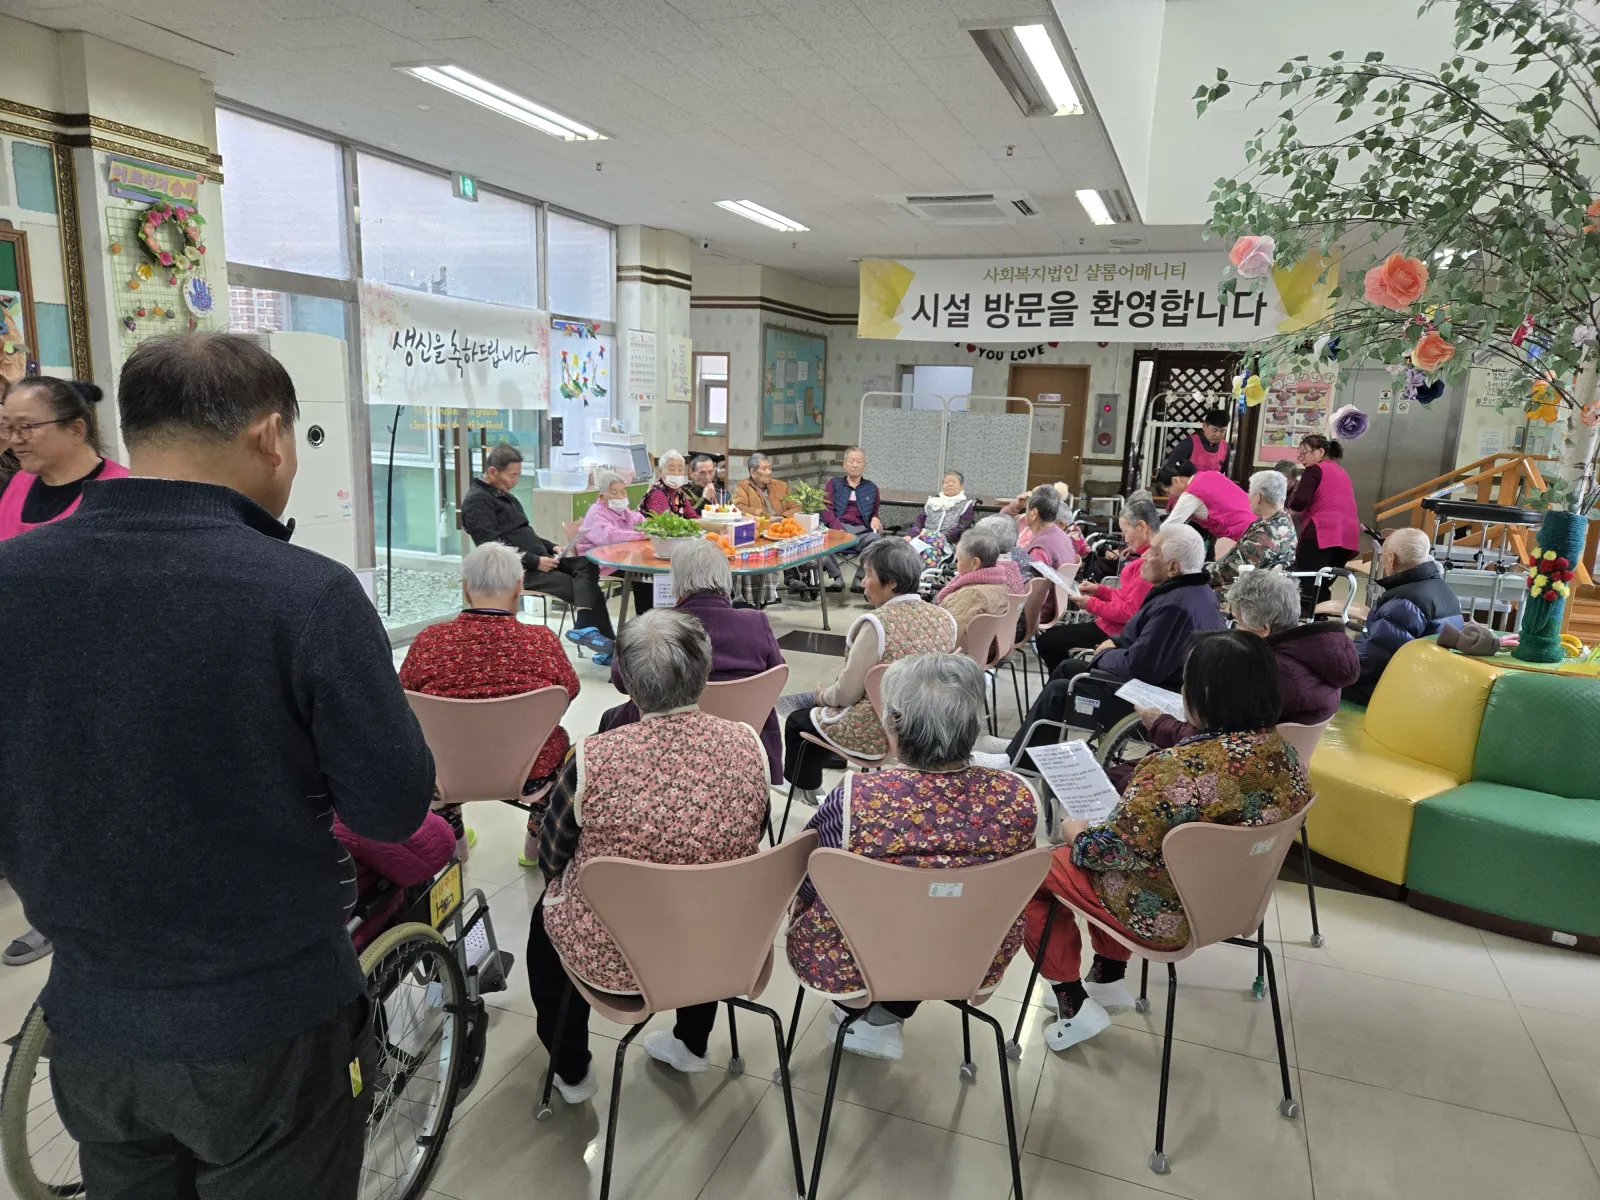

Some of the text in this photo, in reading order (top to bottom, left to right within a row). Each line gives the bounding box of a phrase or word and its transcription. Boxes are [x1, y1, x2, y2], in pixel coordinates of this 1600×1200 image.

[982, 261, 1188, 284] 사회복지법인 샬롬어메니티
[911, 289, 1268, 329] 시설 방문을 환영합니다
[392, 326, 539, 379] 생신을 축하드립니다
[978, 344, 1045, 361] YOU LOVE
